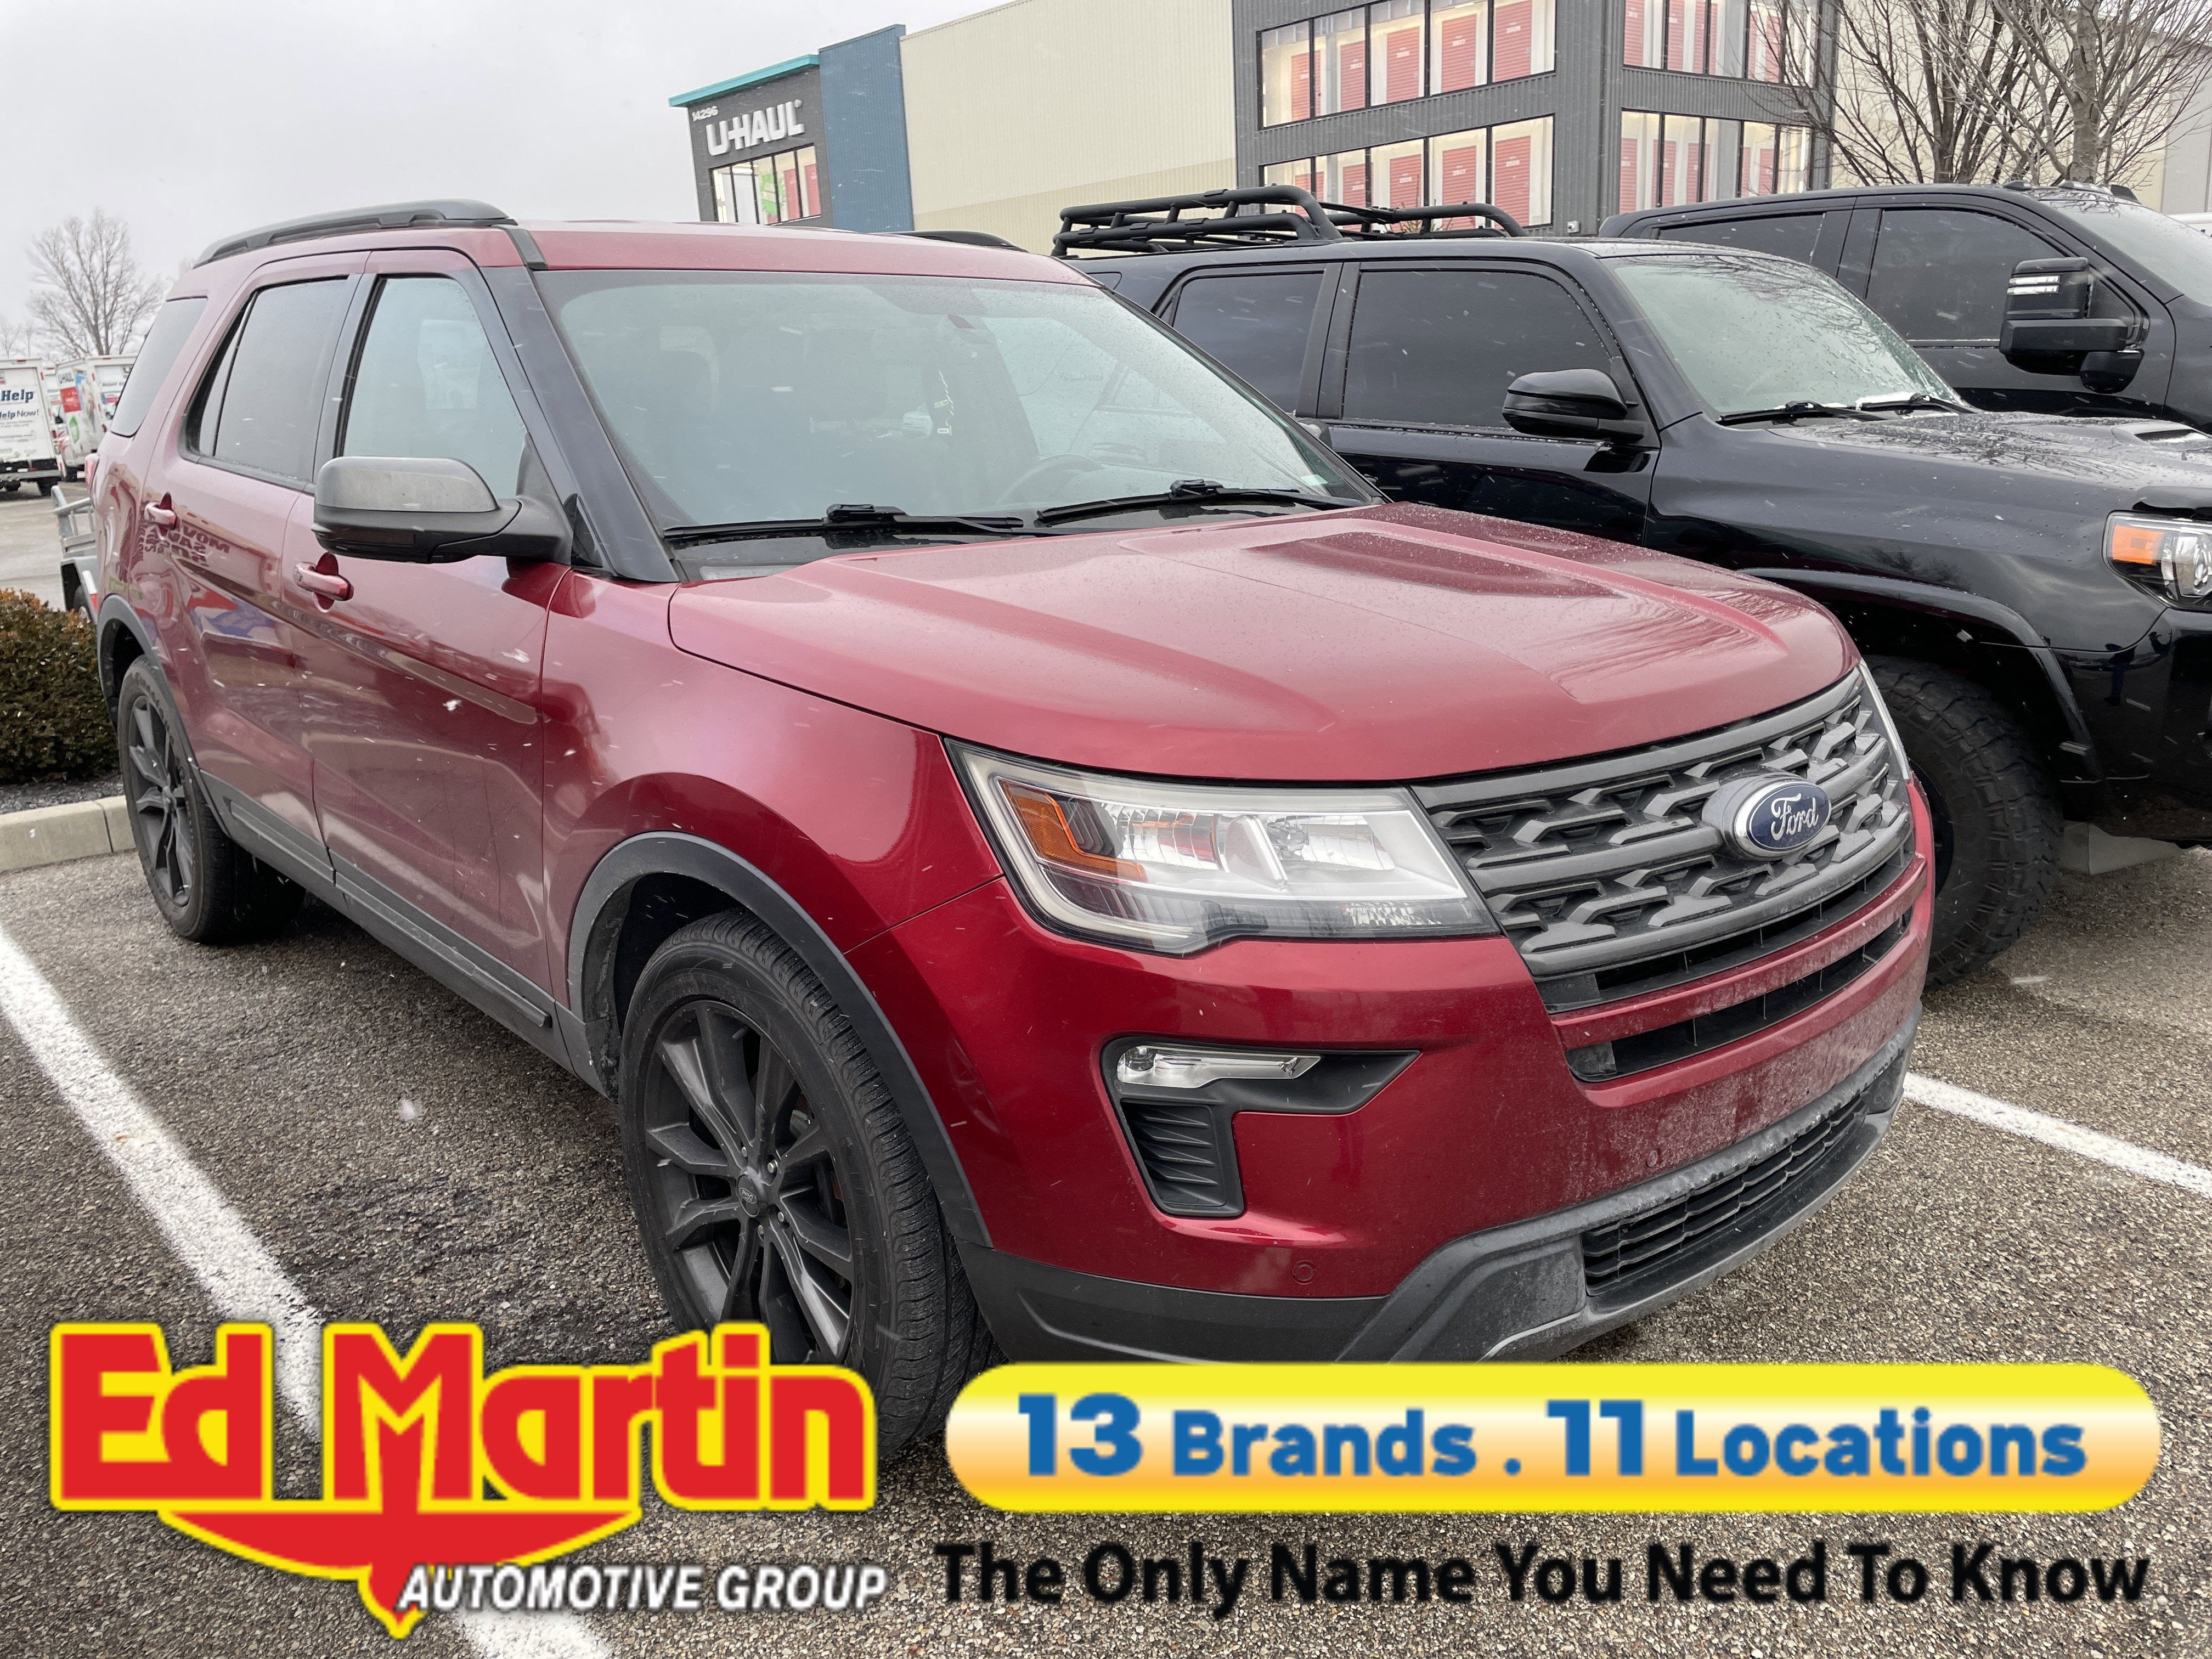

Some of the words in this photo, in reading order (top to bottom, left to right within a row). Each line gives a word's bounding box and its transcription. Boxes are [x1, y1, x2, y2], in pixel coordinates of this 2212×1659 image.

[706, 100, 805, 156] U-HAUL
[1, 389, 35, 403] Help
[1770, 793, 1819, 840] Ford
